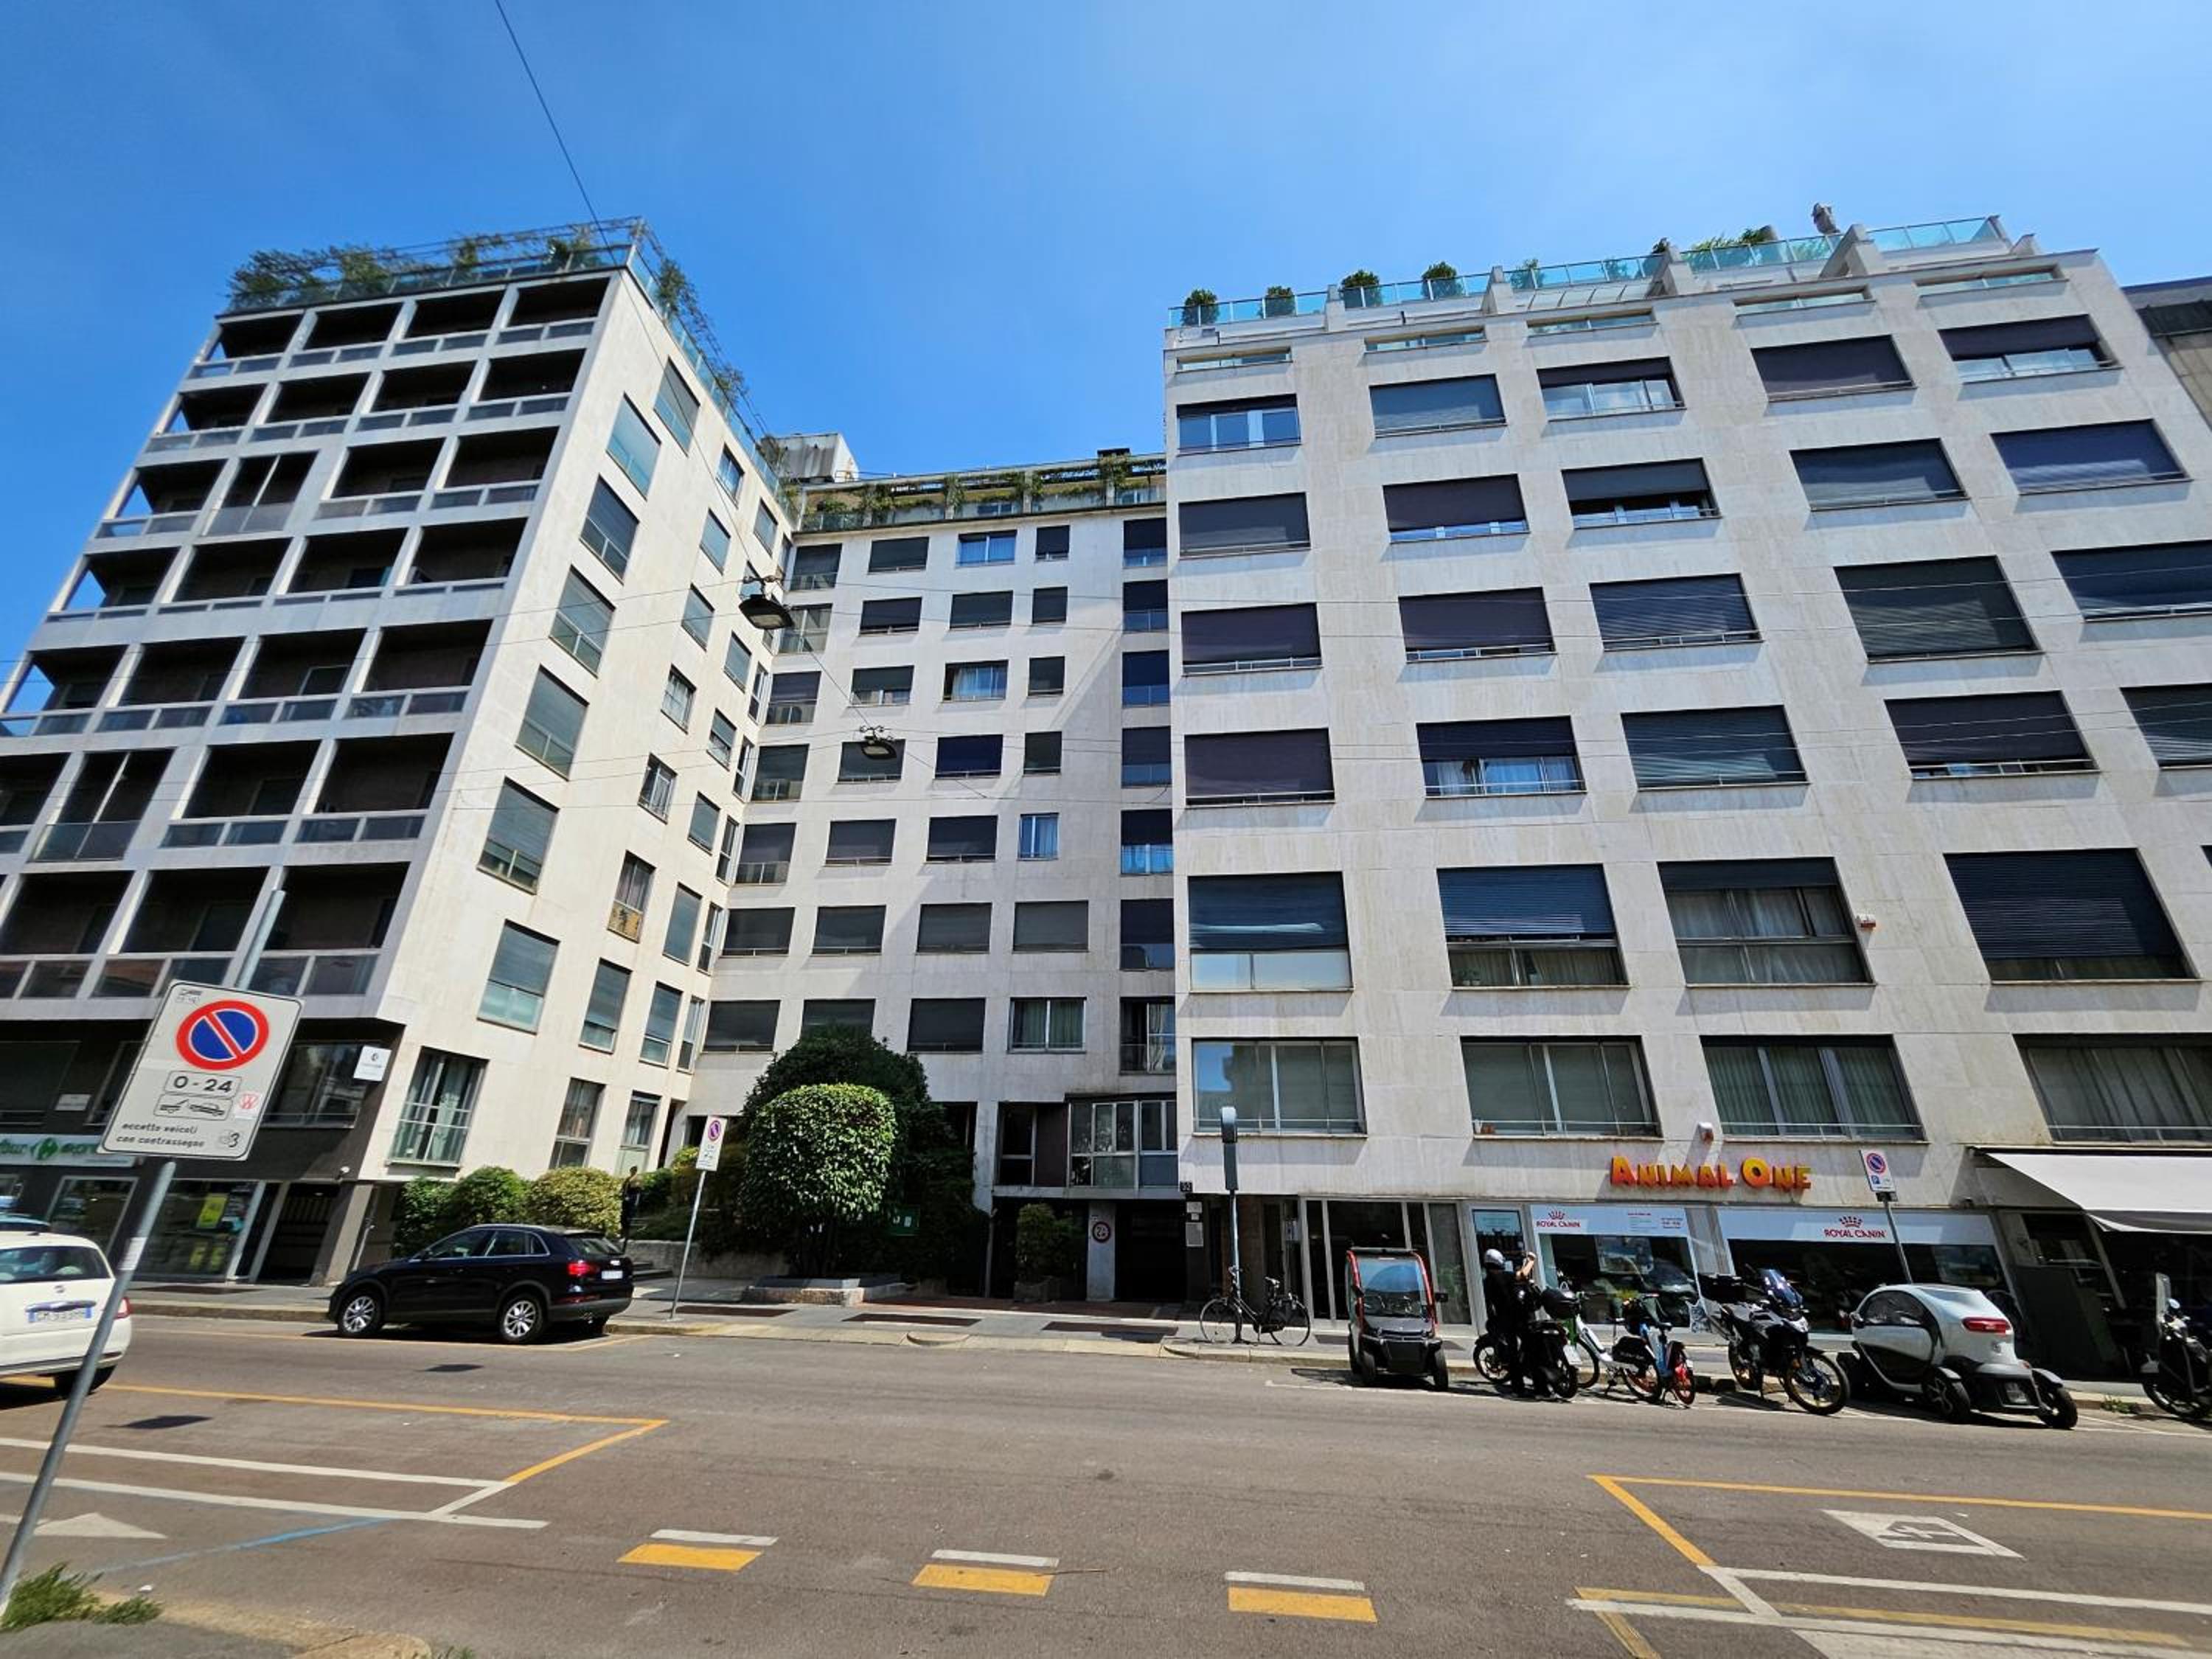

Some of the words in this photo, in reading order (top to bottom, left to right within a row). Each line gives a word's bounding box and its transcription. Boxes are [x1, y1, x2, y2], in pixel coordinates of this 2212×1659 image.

[204, 1079, 233, 1093] 24
[1741, 1156, 1812, 1190] ONE
[1823, 1229, 1853, 1238] ROYAL
[1854, 1229, 1885, 1238] CANIN
